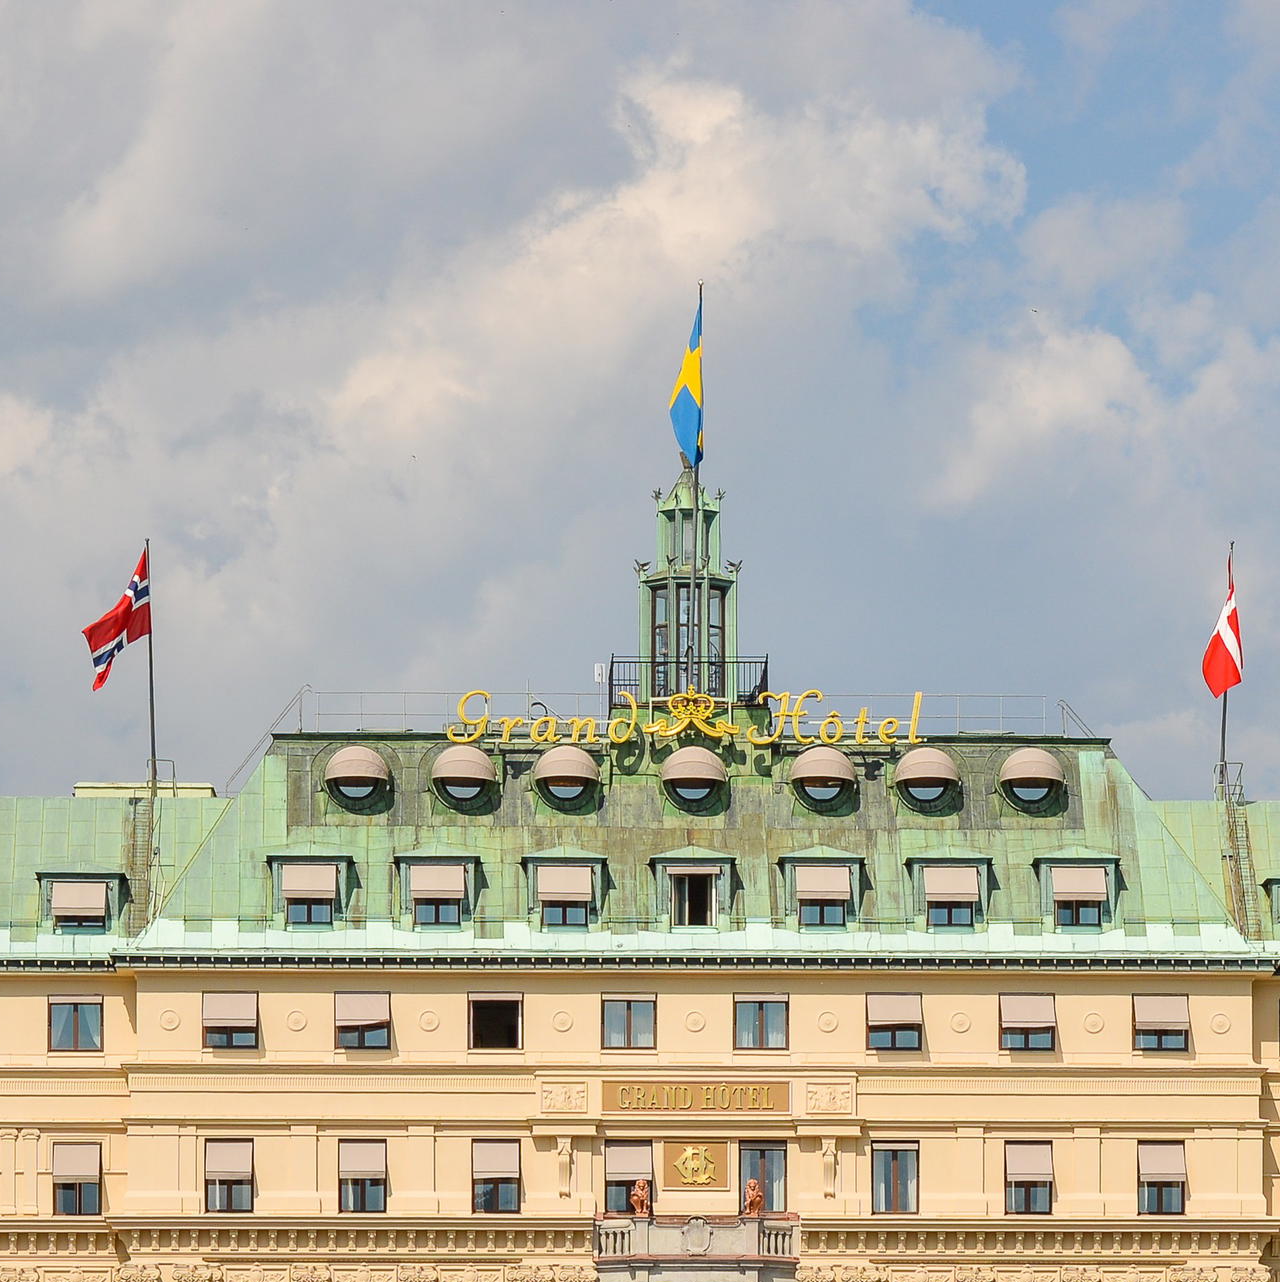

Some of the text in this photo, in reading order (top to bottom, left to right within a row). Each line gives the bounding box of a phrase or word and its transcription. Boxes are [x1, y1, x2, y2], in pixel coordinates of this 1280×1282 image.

[446, 688, 924, 745] Grand Hôtel
[618, 1082, 775, 1110] GRAND HÔTEL
